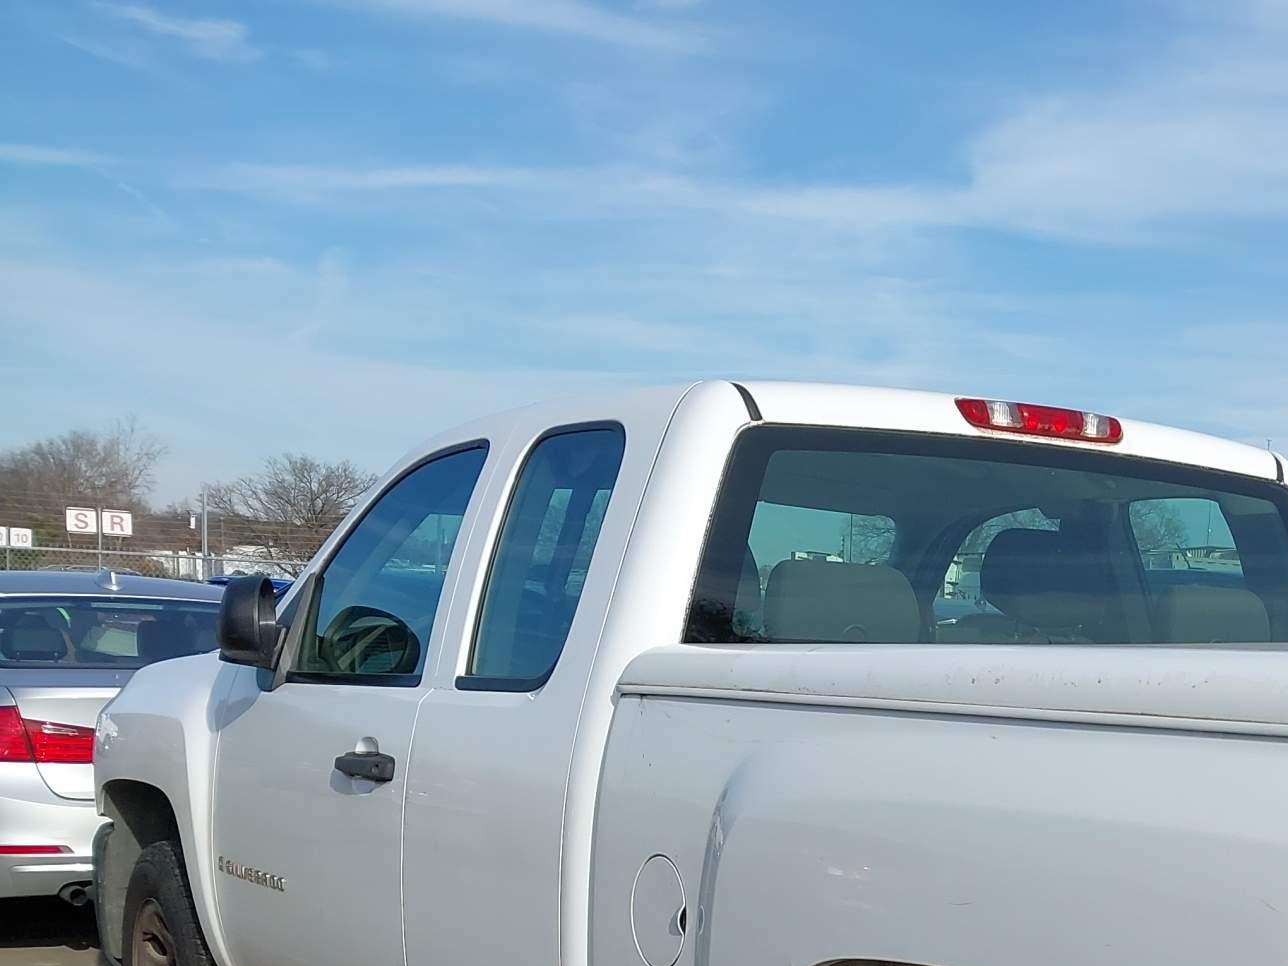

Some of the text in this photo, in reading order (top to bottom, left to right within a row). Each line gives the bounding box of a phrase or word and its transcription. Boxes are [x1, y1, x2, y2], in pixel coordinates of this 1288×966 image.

[74, 512, 89, 530] S
[109, 514, 125, 532] R
[14, 533, 28, 543] 10
